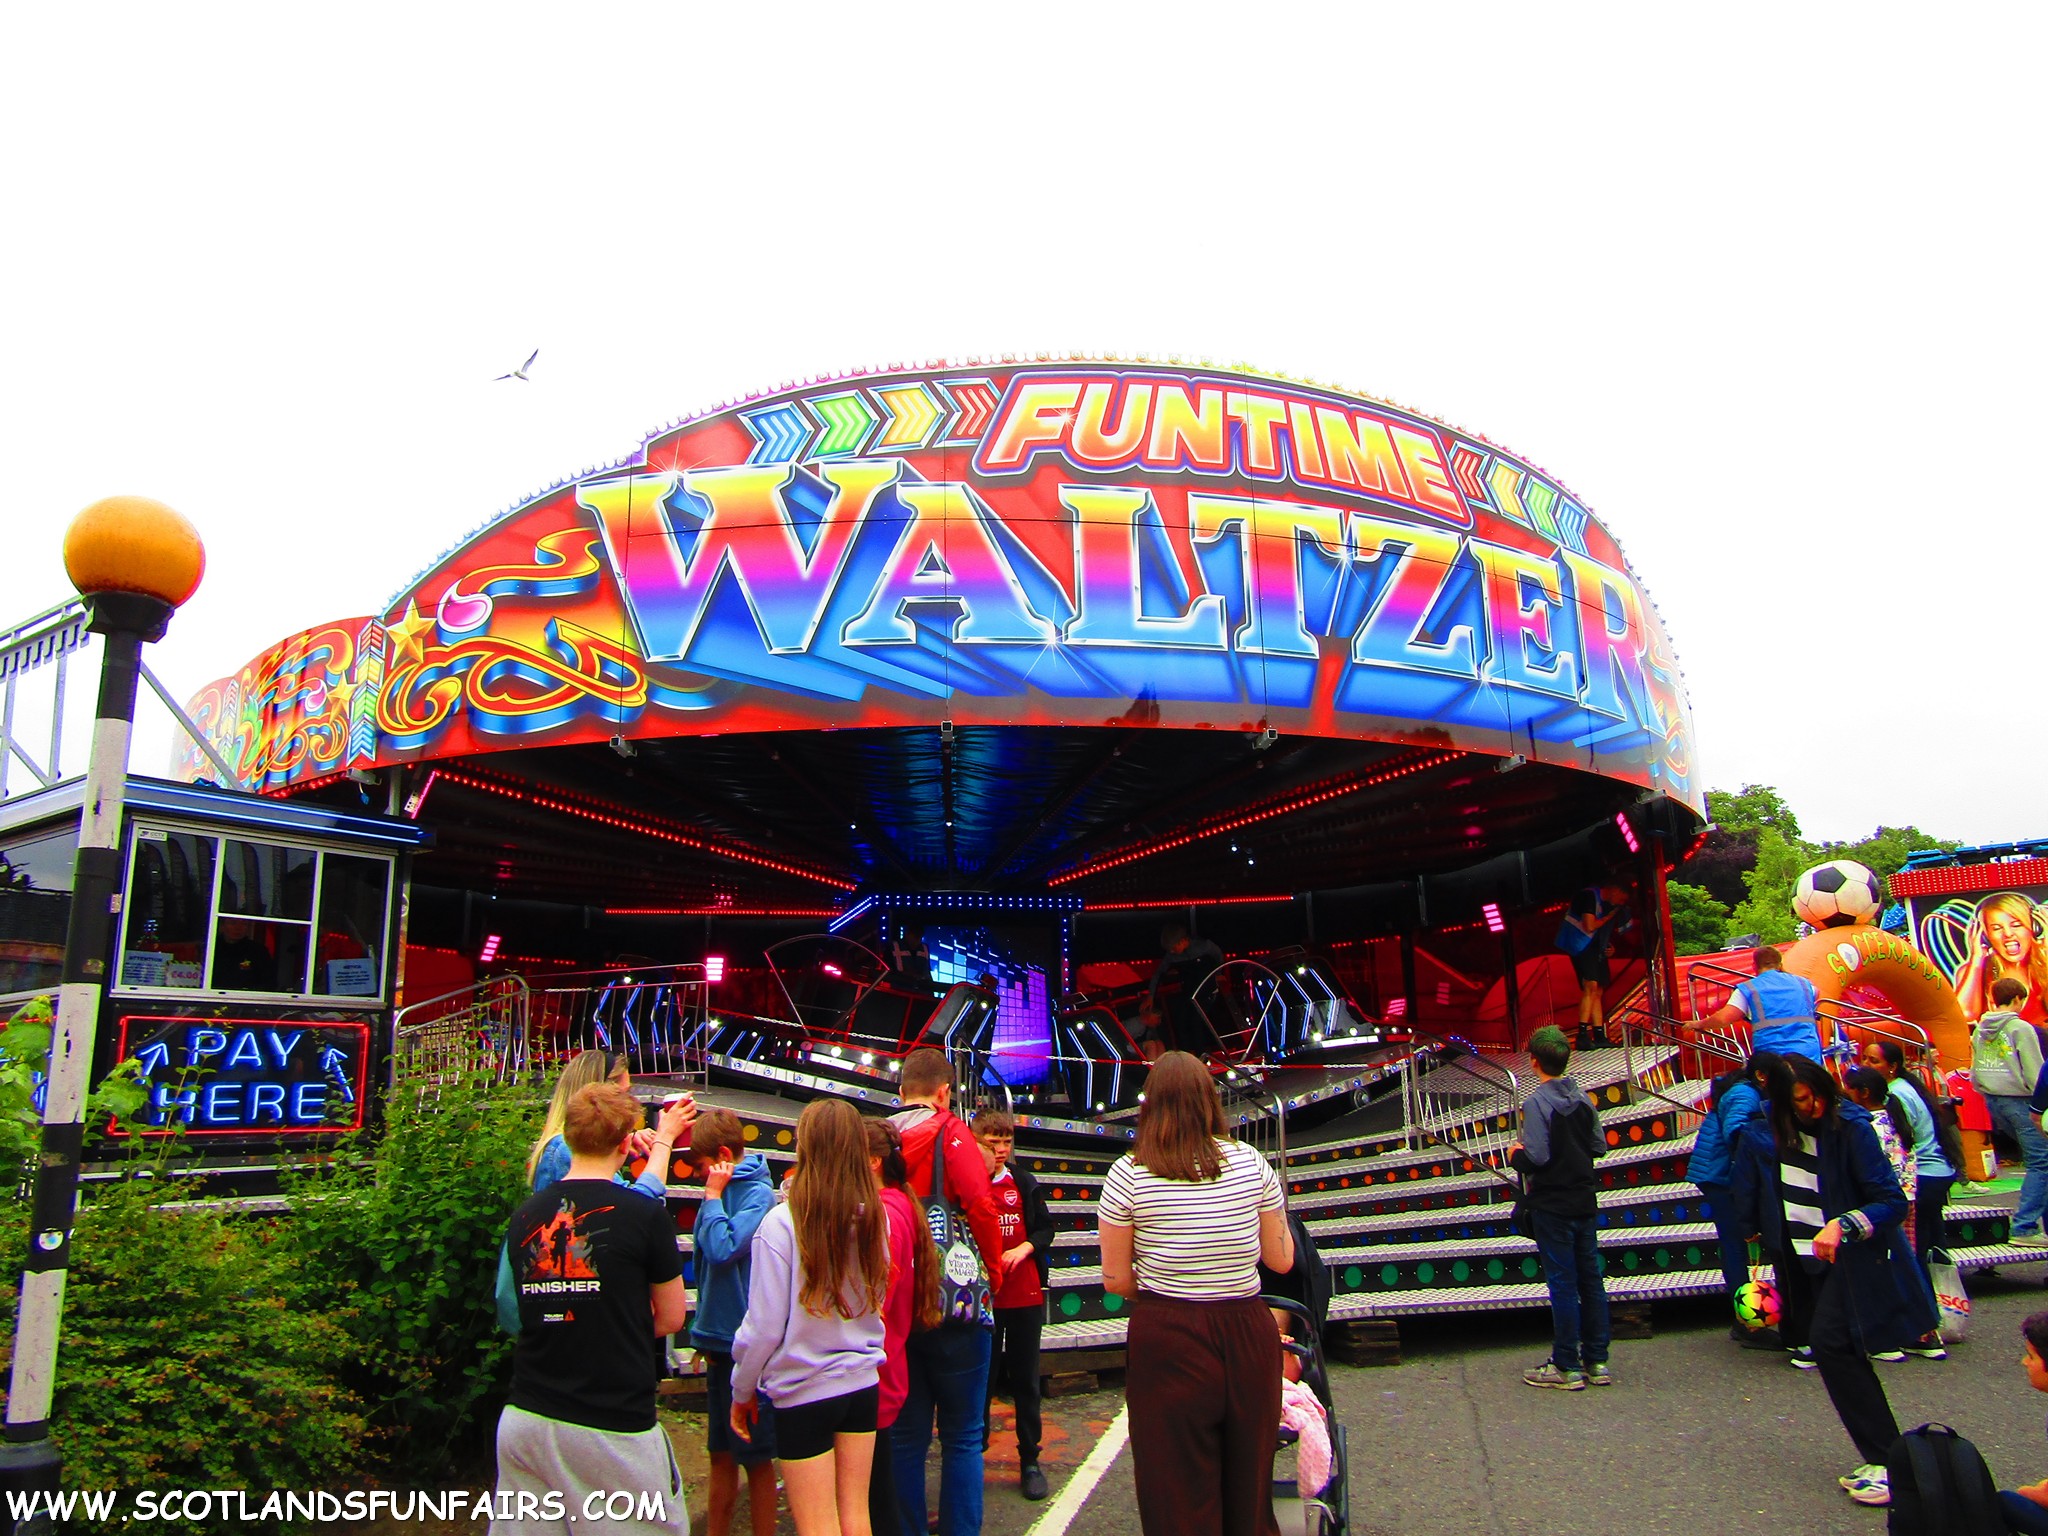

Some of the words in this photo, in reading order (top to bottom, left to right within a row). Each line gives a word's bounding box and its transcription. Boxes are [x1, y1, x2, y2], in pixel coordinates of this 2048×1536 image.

[982, 380, 1469, 522] FUNTIME
[576, 456, 1668, 740] WALTZER
[192, 1029, 301, 1067] PAY
[158, 1084, 328, 1123] HERE
[998, 1213, 1020, 1225] ates
[1000, 1226, 1014, 1236] TER
[522, 1281, 601, 1294] FINISHER
